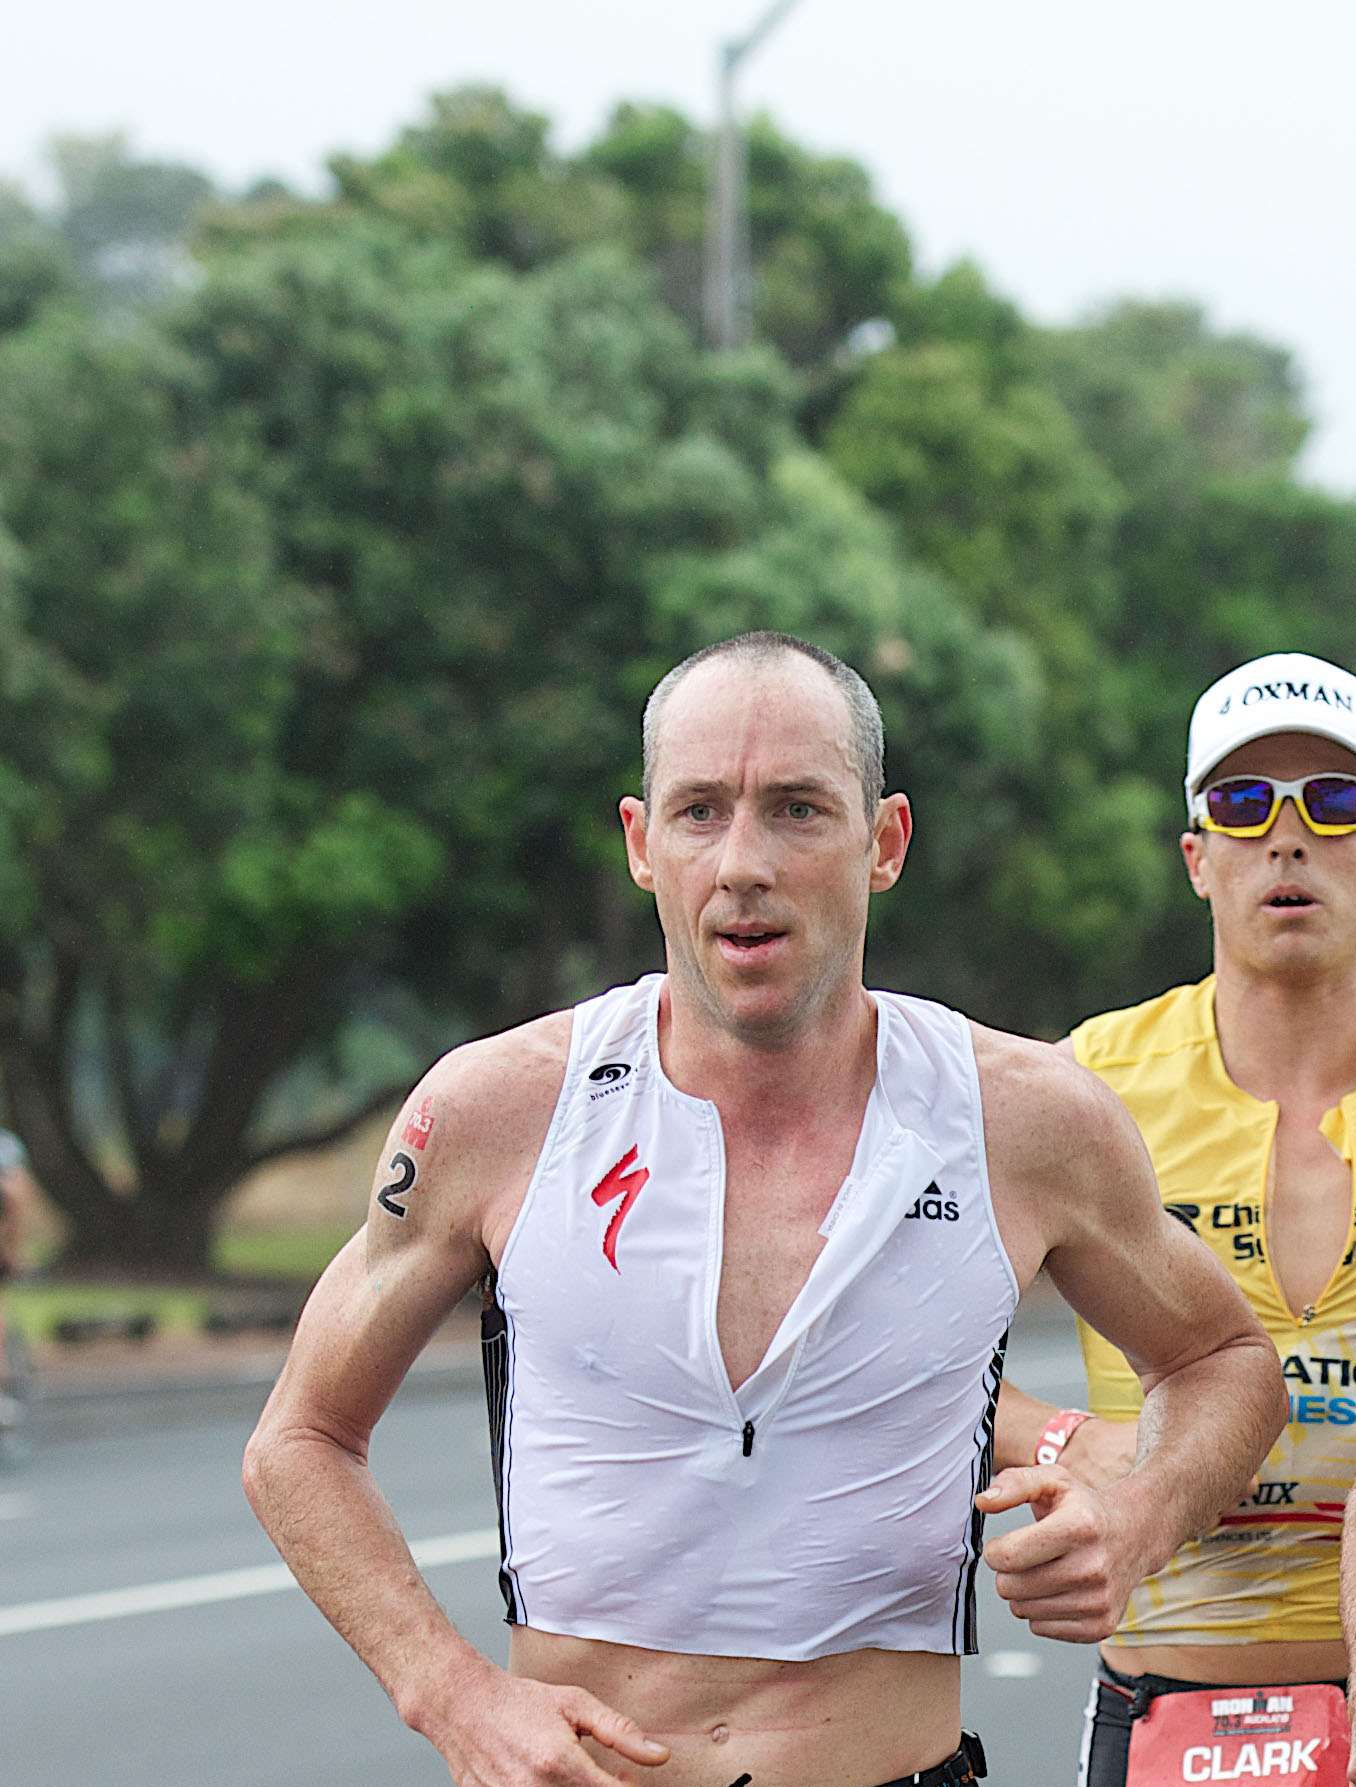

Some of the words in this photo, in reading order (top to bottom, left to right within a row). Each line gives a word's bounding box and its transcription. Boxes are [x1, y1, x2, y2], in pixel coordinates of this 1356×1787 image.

[376, 1151, 417, 1218] 2
[1037, 1429, 1067, 1464] 10
[1182, 1737, 1321, 1783] CLARK
